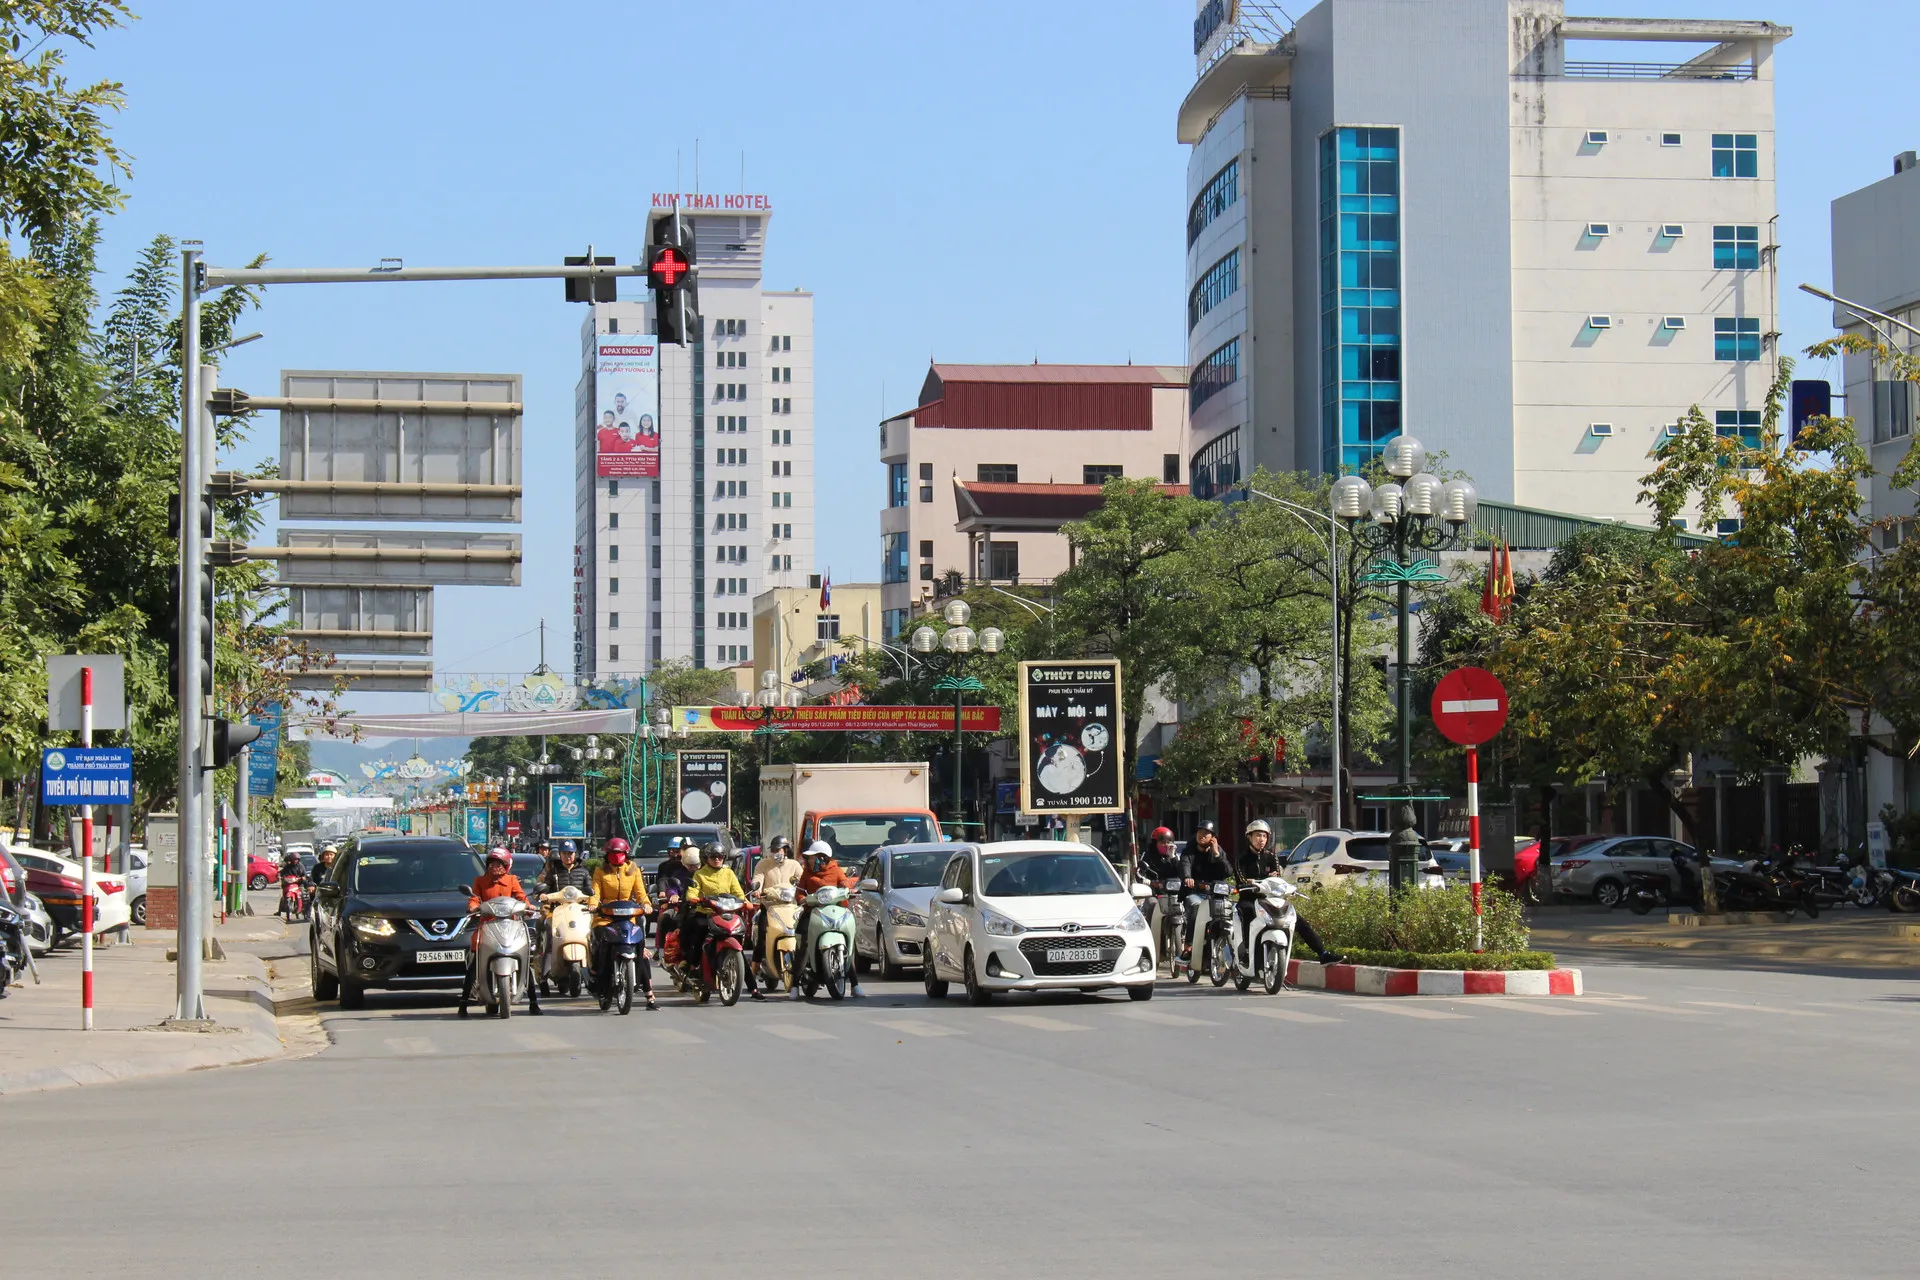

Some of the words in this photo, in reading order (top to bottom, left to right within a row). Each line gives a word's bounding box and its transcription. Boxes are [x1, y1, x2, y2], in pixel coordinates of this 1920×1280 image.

[652, 193, 680, 207] KIM
[685, 194, 719, 208] THAI
[725, 194, 772, 209] HOTEL
[602, 347, 621, 355] APAX
[622, 347, 651, 355] ENGLISH
[574, 545, 583, 577] KIM
[575, 582, 583, 626] THAI
[1077, 670, 1112, 680] DUNG
[46, 774, 65, 796] TUYẾN
[66, 774, 79, 796] PHỐ
[80, 777, 92, 796] VĂN
[93, 780, 109, 796] MINH
[120, 780, 129, 799] THỊ
[558, 795, 578, 815] 26
[1070, 797, 1090, 805] 1900
[1092, 796, 1112, 805] 1202
[471, 815, 485, 829] 26
[1049, 950, 1098, 961] 20A-283.65
